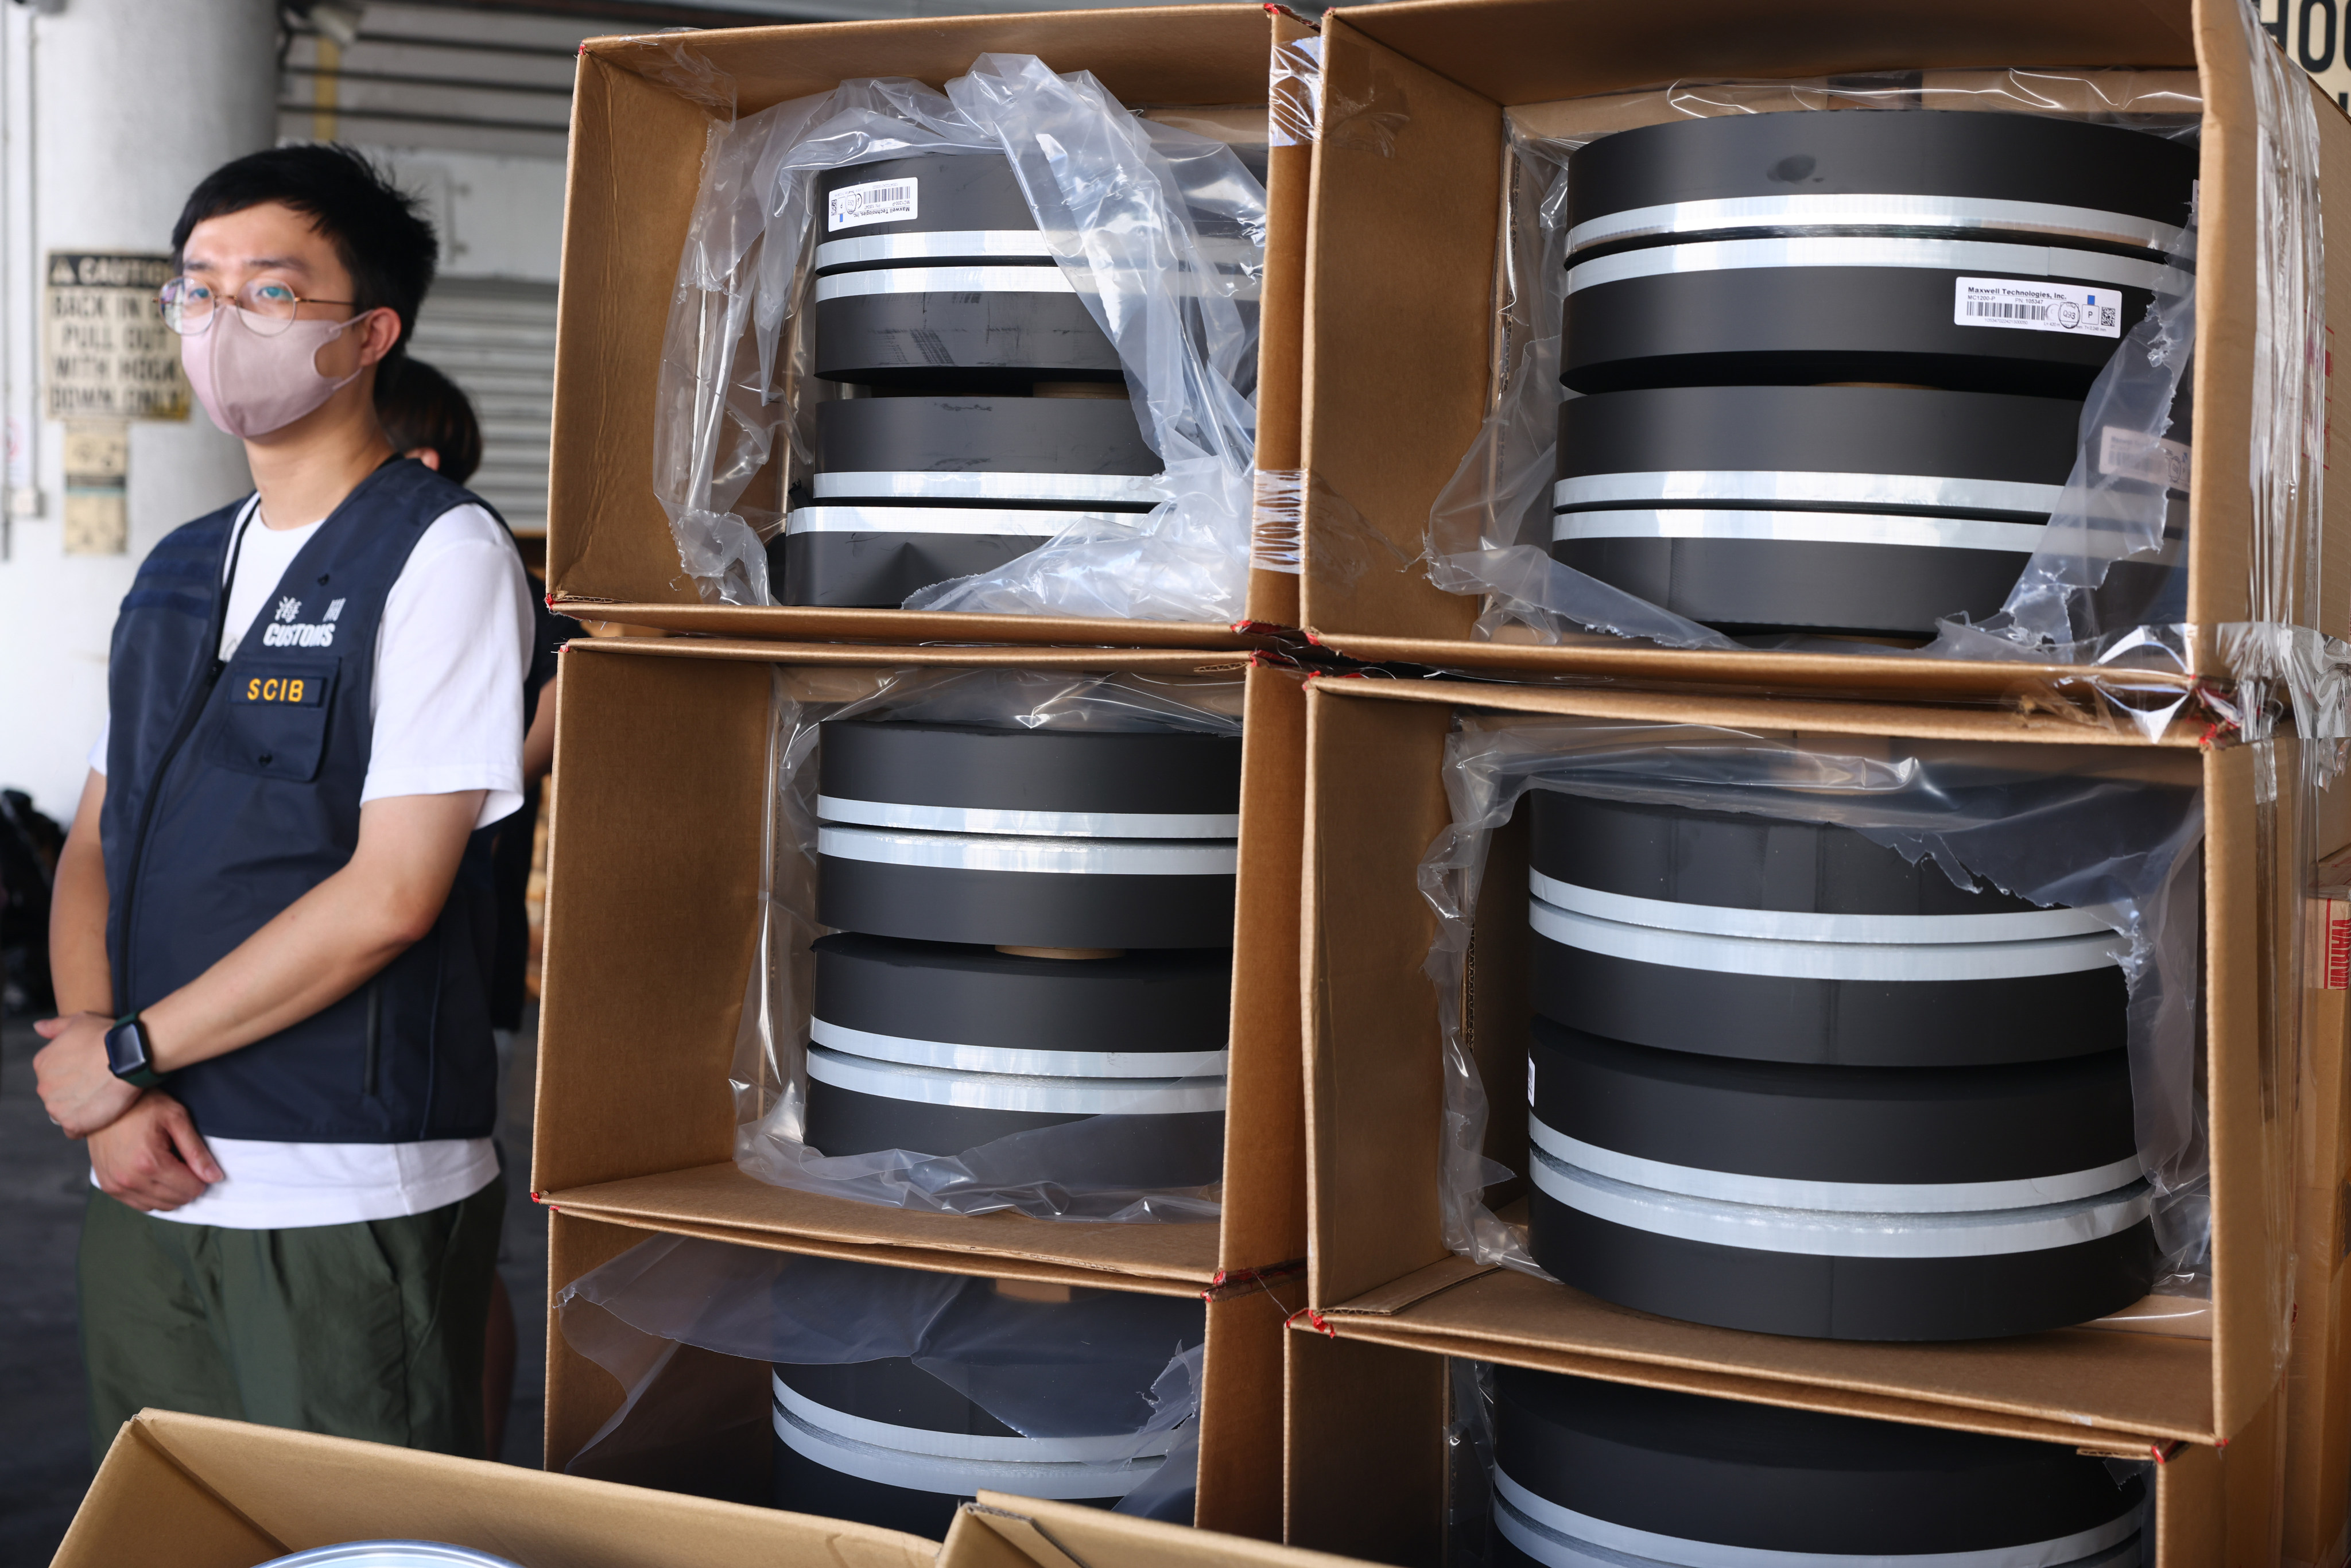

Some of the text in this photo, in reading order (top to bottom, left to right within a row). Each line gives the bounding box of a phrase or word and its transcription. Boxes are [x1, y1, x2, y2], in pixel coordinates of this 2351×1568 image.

[2253, 0, 2351, 73] HO
[860, 208, 889, 216] Technologies,
[2002, 289, 2052, 298] Technologies,
[2063, 310, 2076, 320] Q93
[263, 623, 336, 647] CUSTOMS
[247, 678, 304, 702] SCIB
